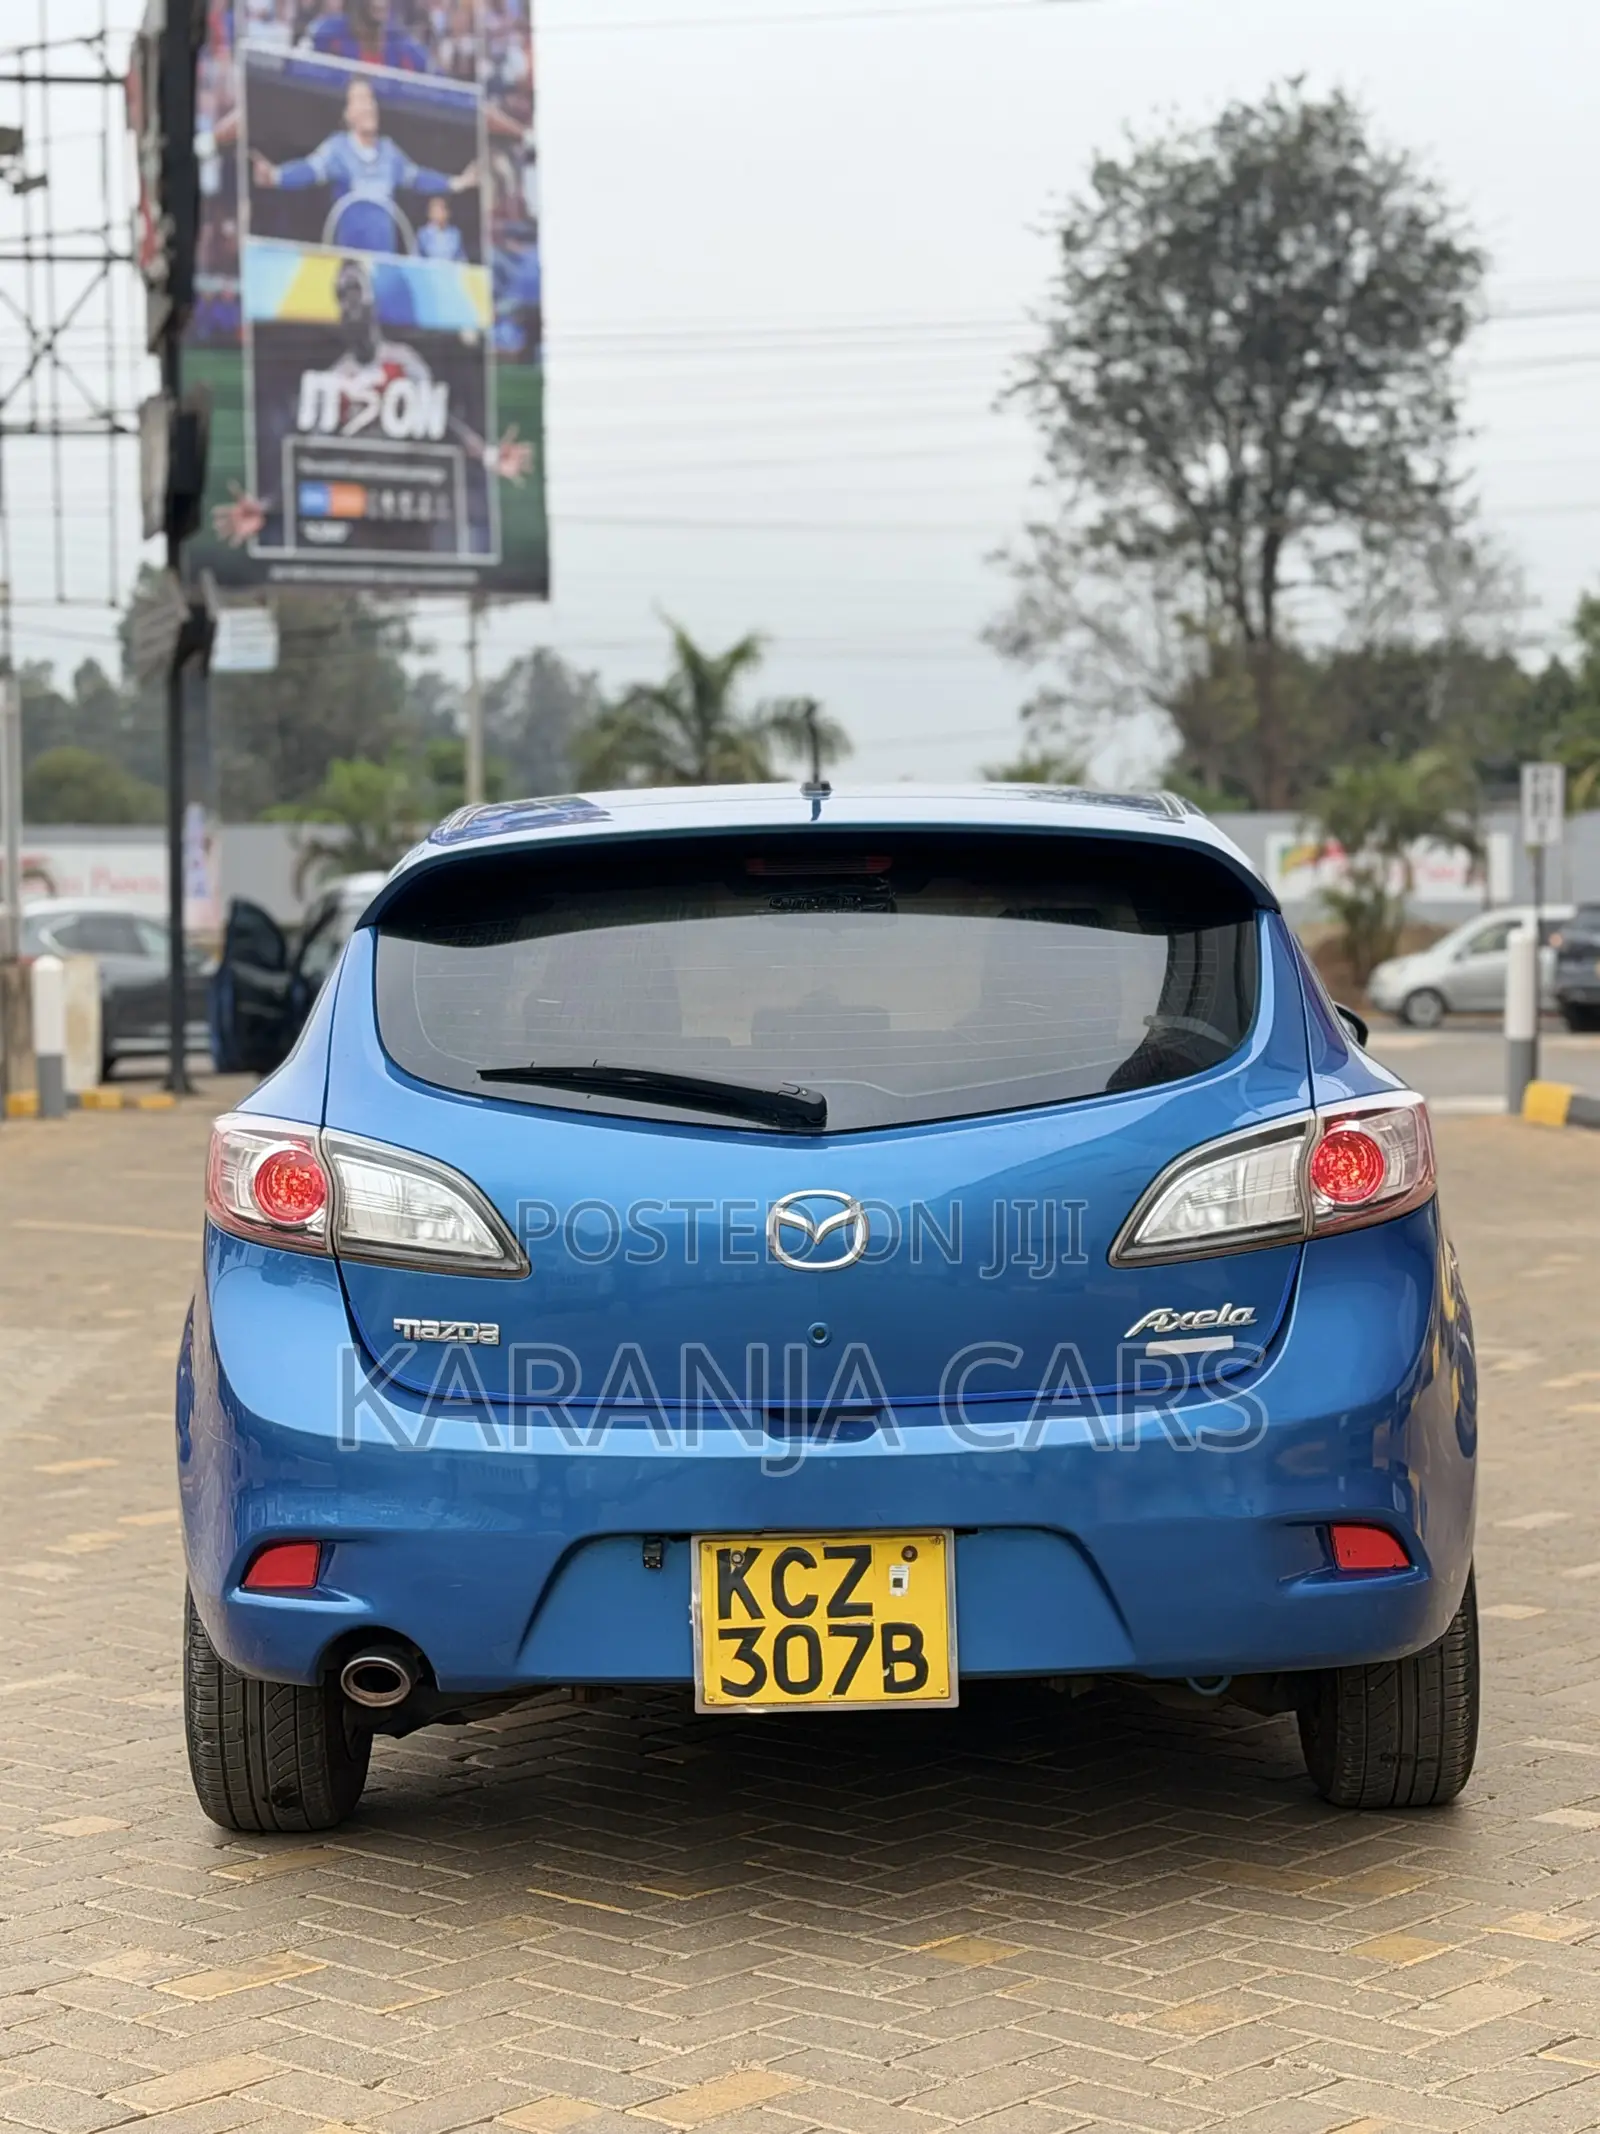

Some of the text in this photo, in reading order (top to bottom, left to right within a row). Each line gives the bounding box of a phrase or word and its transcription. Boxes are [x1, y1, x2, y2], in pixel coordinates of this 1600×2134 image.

[1123, 1302, 1258, 1339] Axela
[716, 1544, 874, 1620] KCZ
[718, 1621, 929, 1697] 307B
